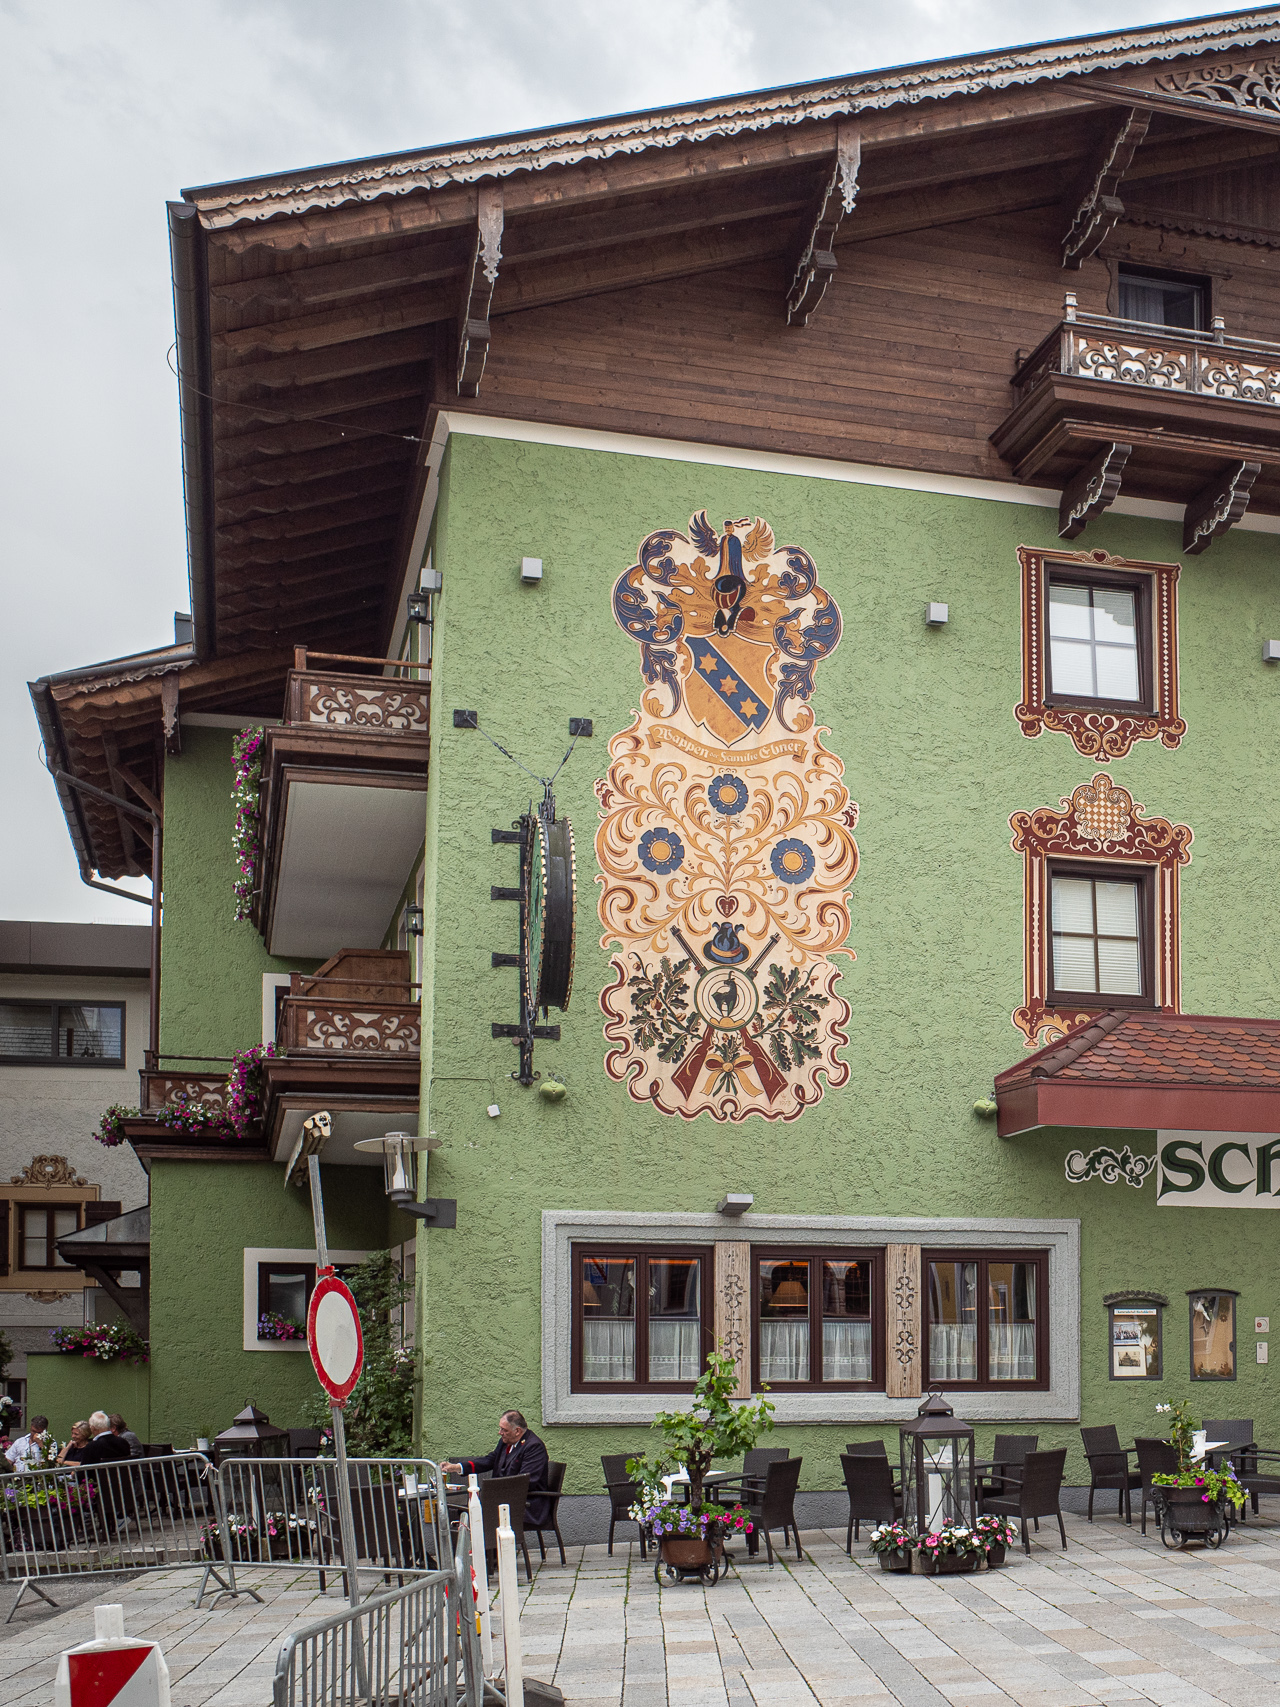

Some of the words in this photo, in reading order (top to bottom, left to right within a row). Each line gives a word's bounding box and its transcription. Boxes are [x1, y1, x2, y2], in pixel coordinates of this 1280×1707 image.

[653, 727, 708, 758] Wappen
[719, 751, 758, 763] Familie
[758, 742, 801, 759] Ebner
